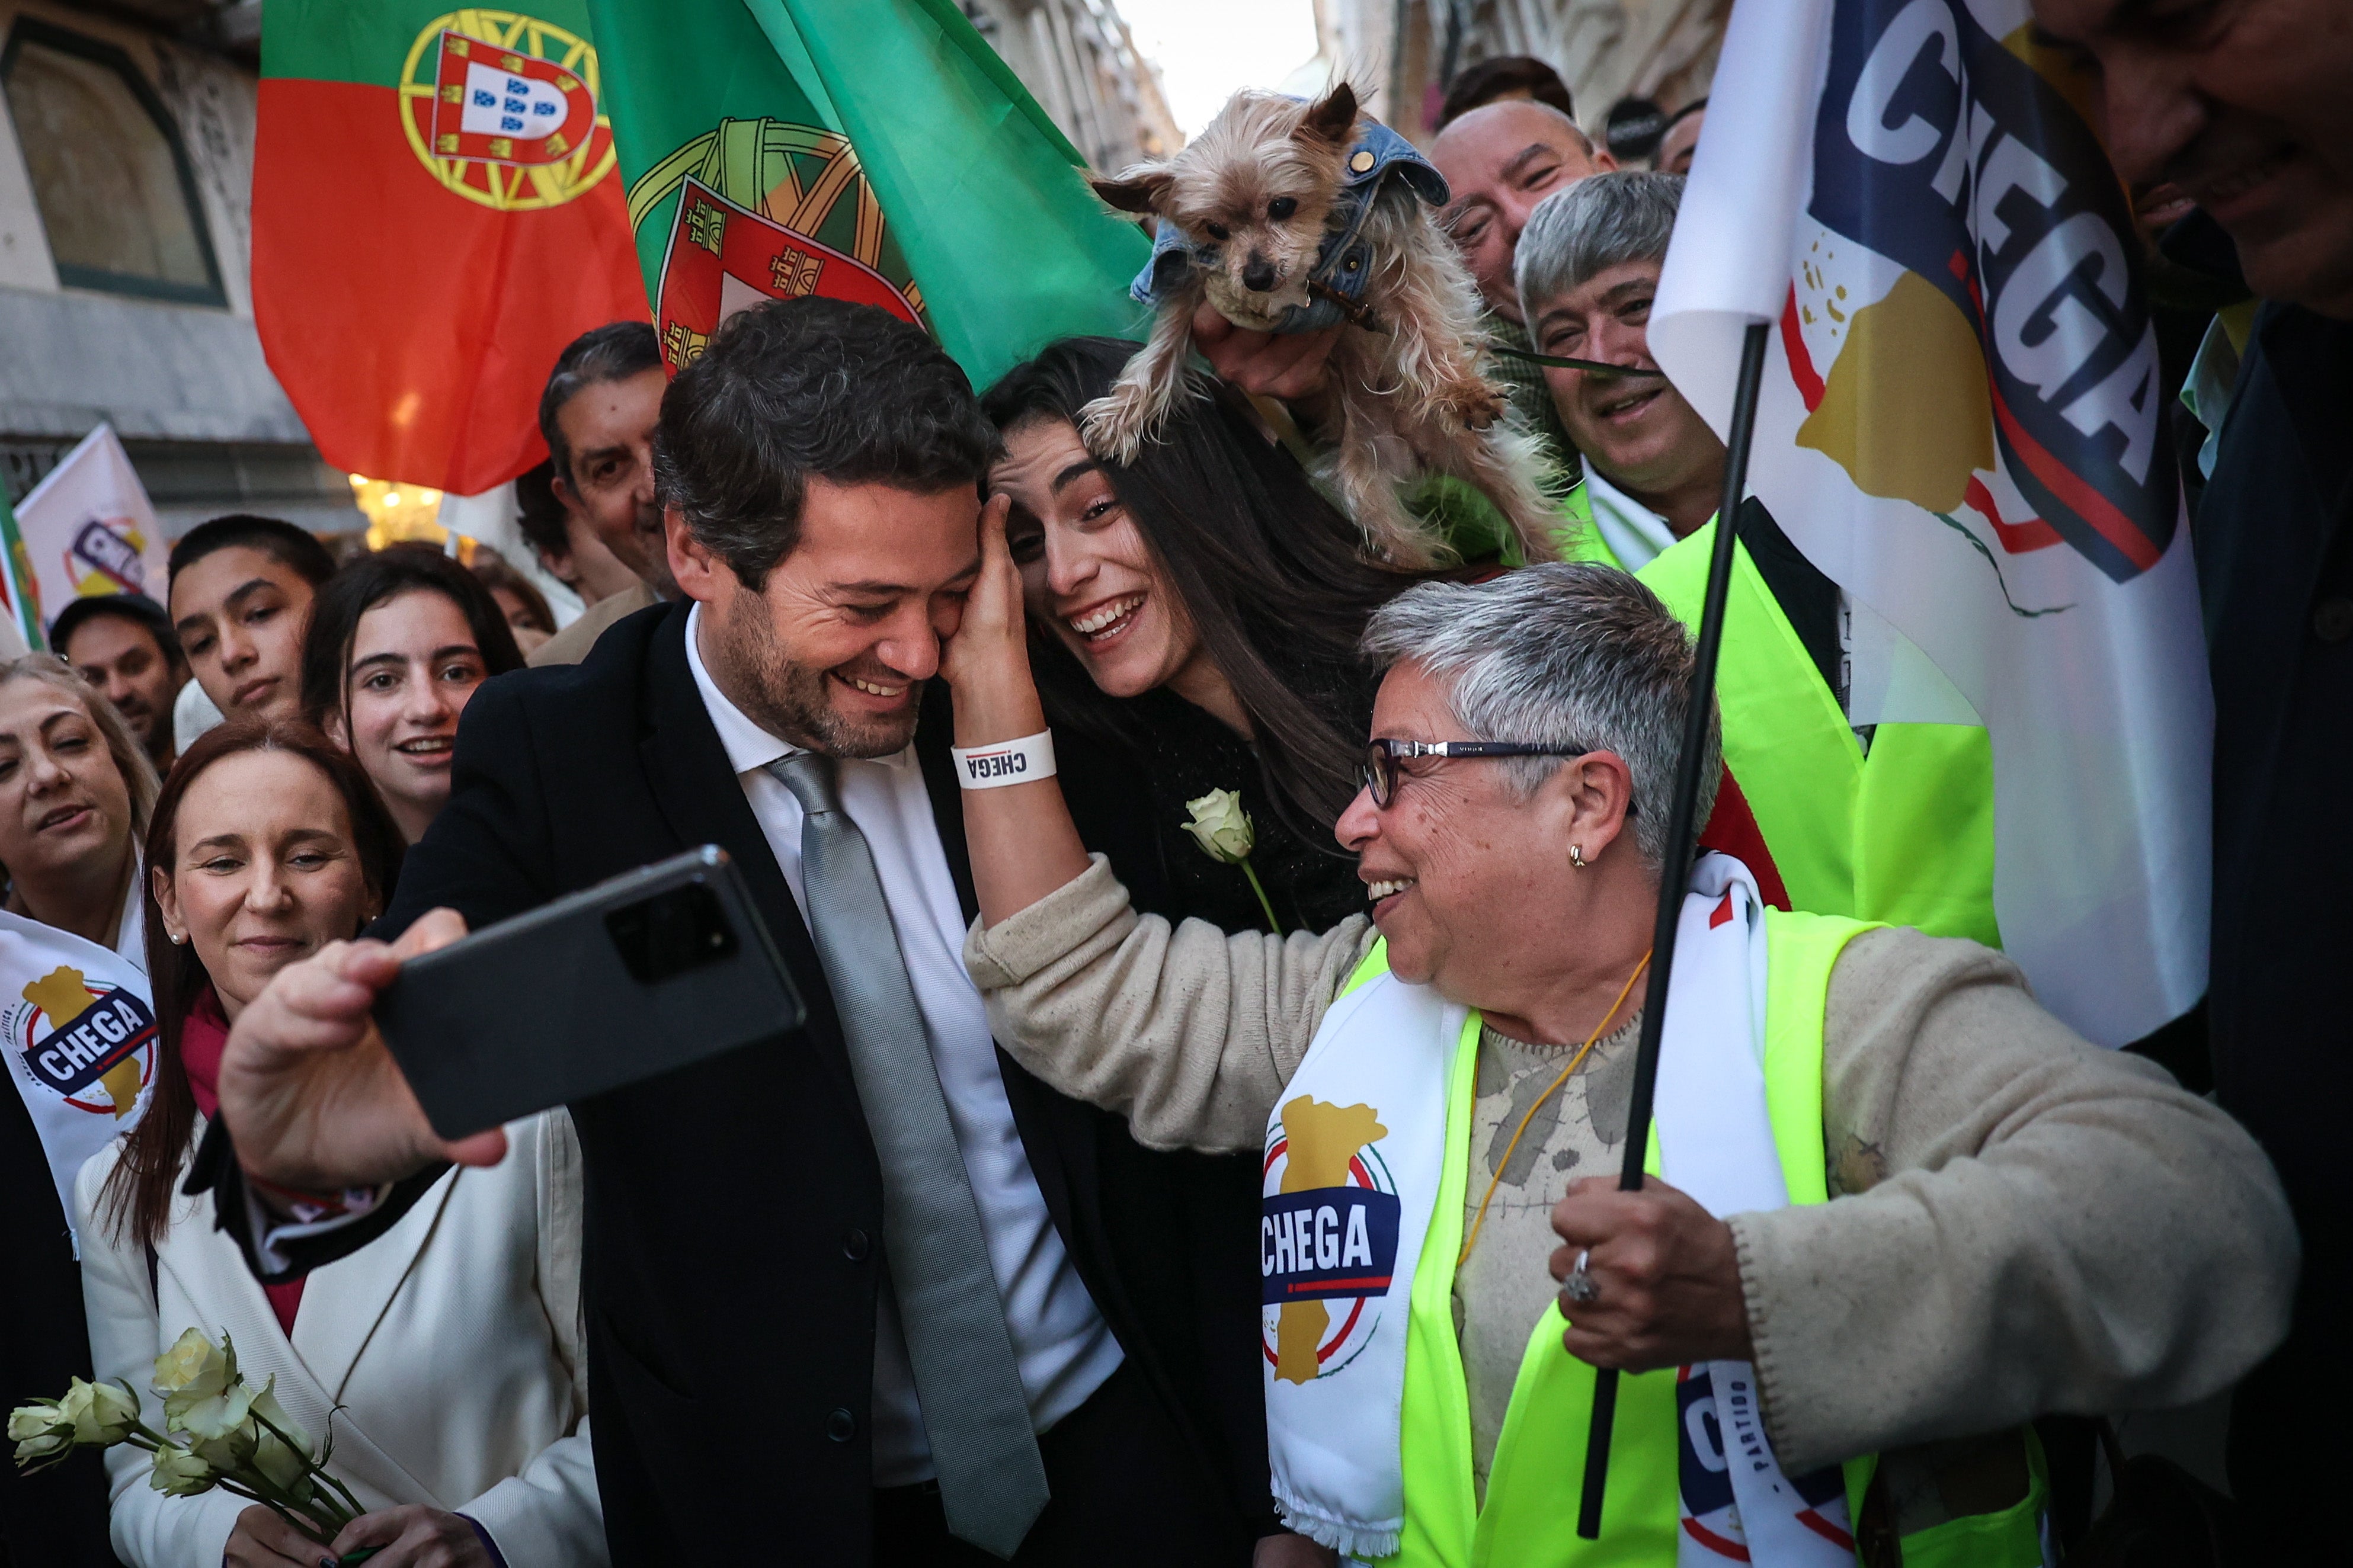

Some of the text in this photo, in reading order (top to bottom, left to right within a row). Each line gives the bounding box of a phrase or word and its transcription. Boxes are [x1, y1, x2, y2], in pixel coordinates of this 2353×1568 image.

[1846, 0, 2160, 486] CHEGA
[967, 752, 1027, 778] CHEGA
[39, 999, 144, 1080] CHEGA
[1262, 1204, 1372, 1277] CHEGA
[1731, 1381, 1769, 1471] PARTIDO
